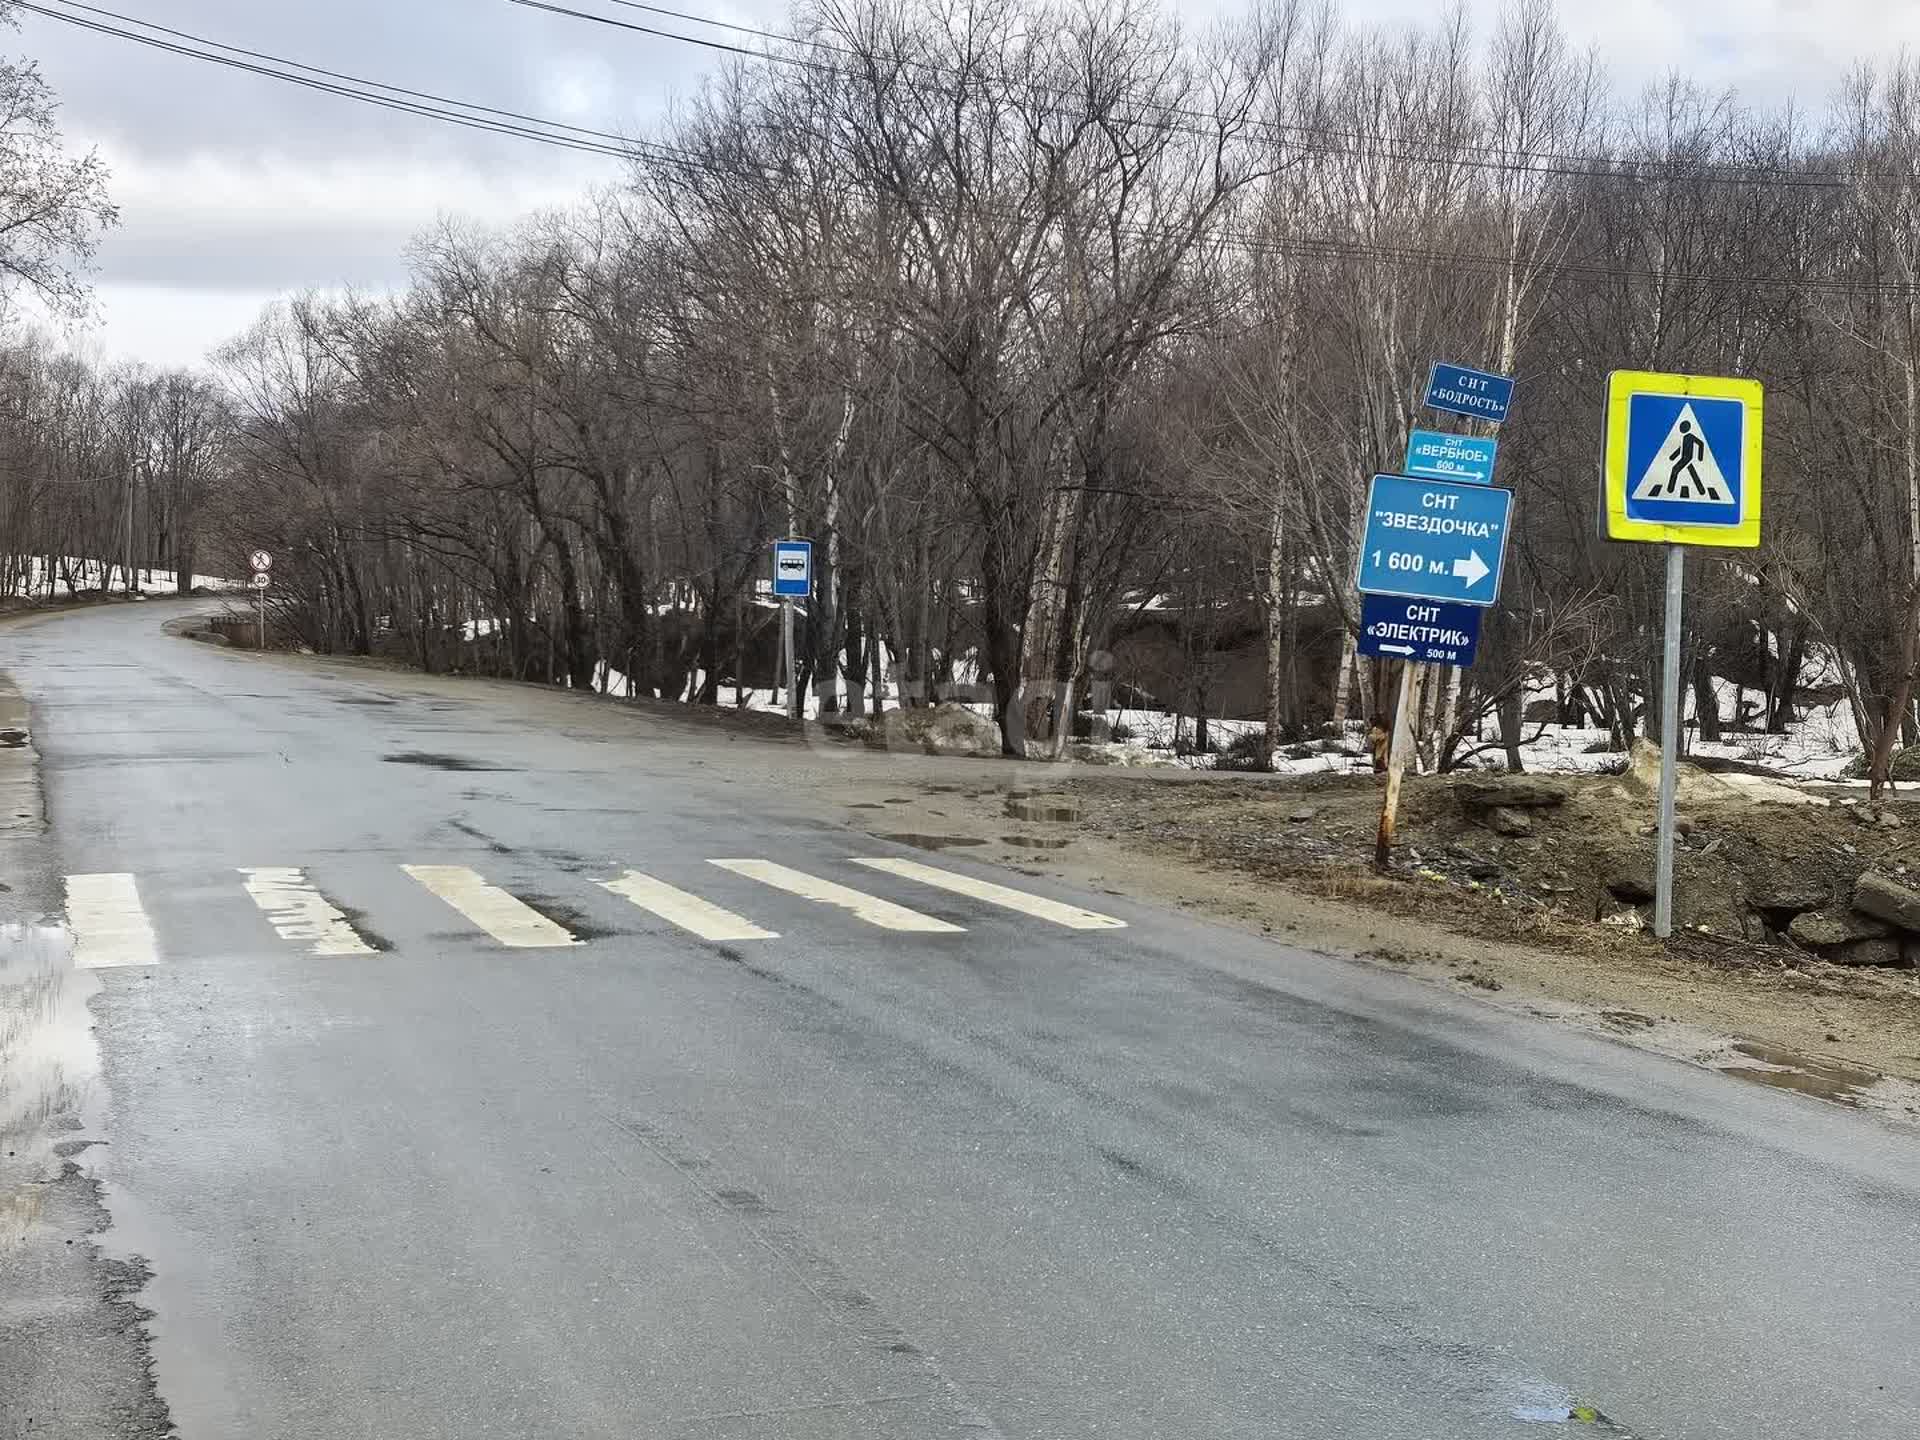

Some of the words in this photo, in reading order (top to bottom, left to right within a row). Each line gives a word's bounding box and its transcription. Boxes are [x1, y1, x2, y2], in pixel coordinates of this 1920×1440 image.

[1458, 376, 1488, 392] СНТ
[1432, 388, 1505, 412] «БОДРОСТЬ»
[1445, 438, 1464, 447] СНТ
[1415, 444, 1488, 462] «ВЕРБНОЕ»
[1436, 460, 1454, 471] 600
[1422, 493, 1459, 510] СНТ
[1375, 511, 1499, 538] "ЗВЕЗДОЧКА"
[1371, 550, 1381, 567] 1
[1388, 552, 1423, 572] 600
[1429, 561, 1449, 575] м.
[1406, 605, 1440, 622] СНТ
[1367, 622, 1469, 647] «ЭЛЕКТРИК»
[1426, 648, 1445, 659] 500
